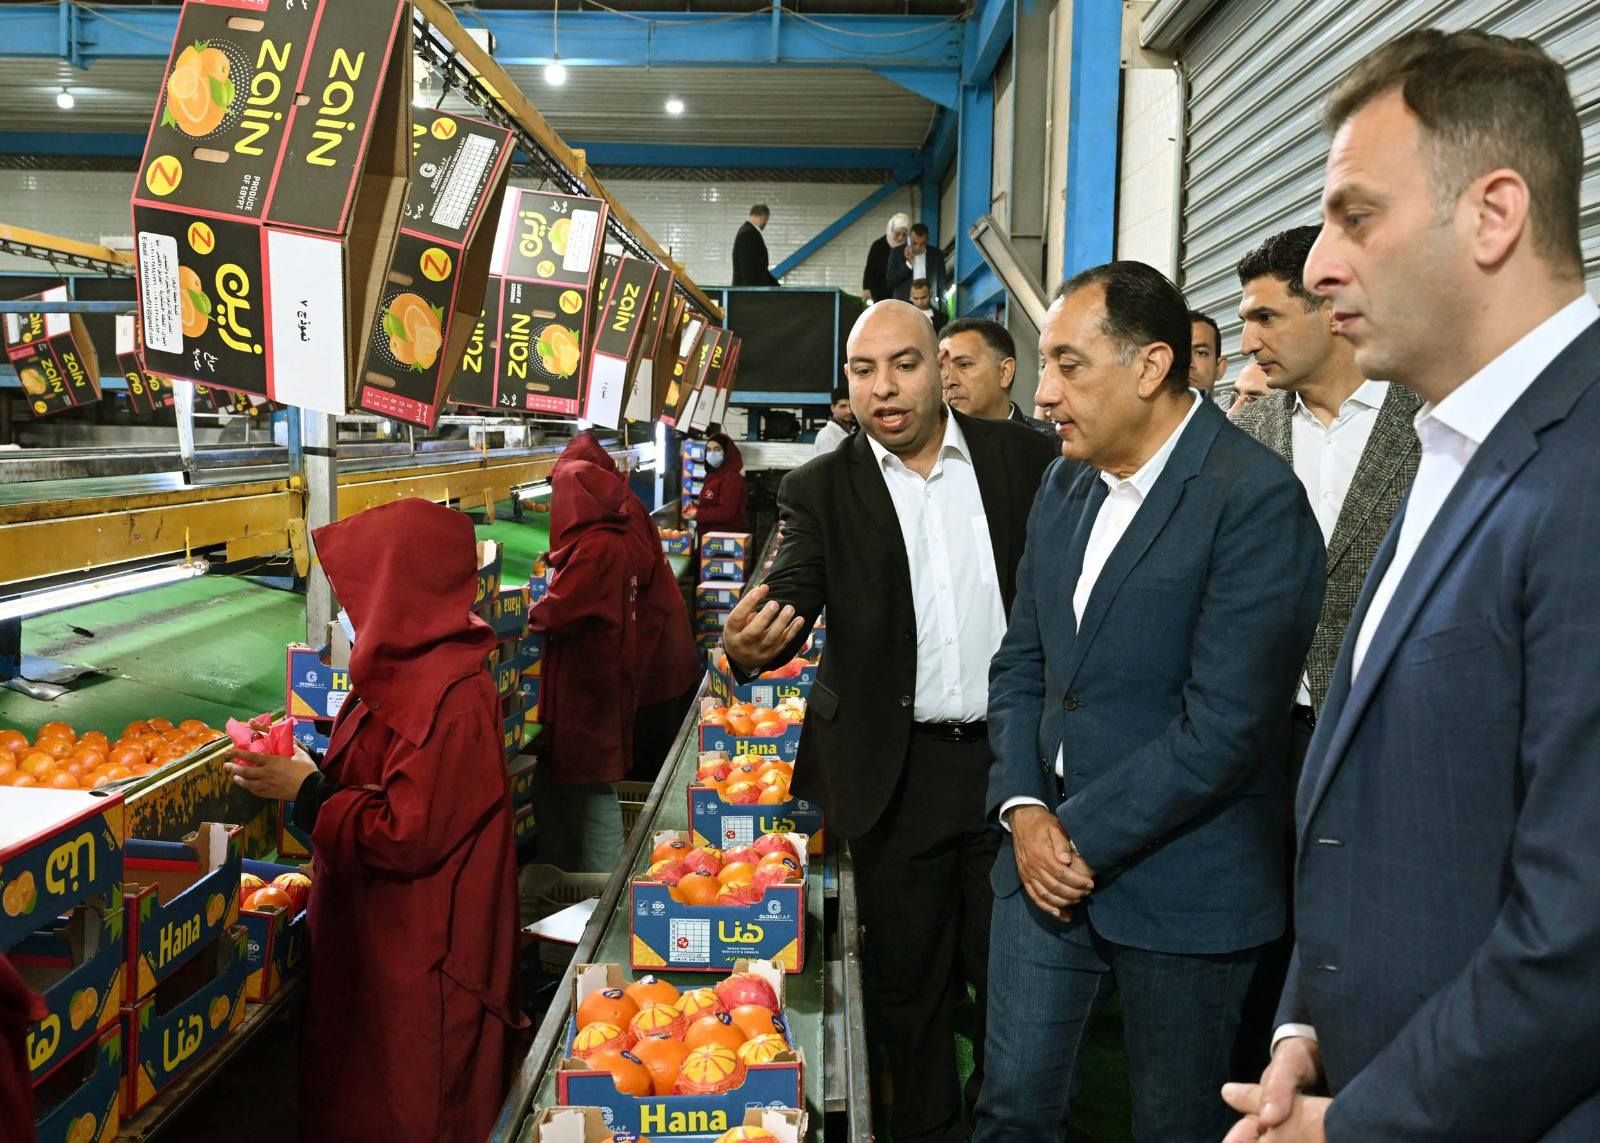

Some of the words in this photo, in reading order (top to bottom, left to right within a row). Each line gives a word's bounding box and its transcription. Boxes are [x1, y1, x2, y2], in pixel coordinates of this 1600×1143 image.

[243, 174, 252, 188] OF
[248, 176, 261, 211] PRODUCE
[736, 740, 777, 755] Hana
[160, 914, 200, 968] Hana
[718, 920, 764, 943] هنا
[163, 1014, 204, 1072] هنا
[640, 1104, 728, 1134] Hana
